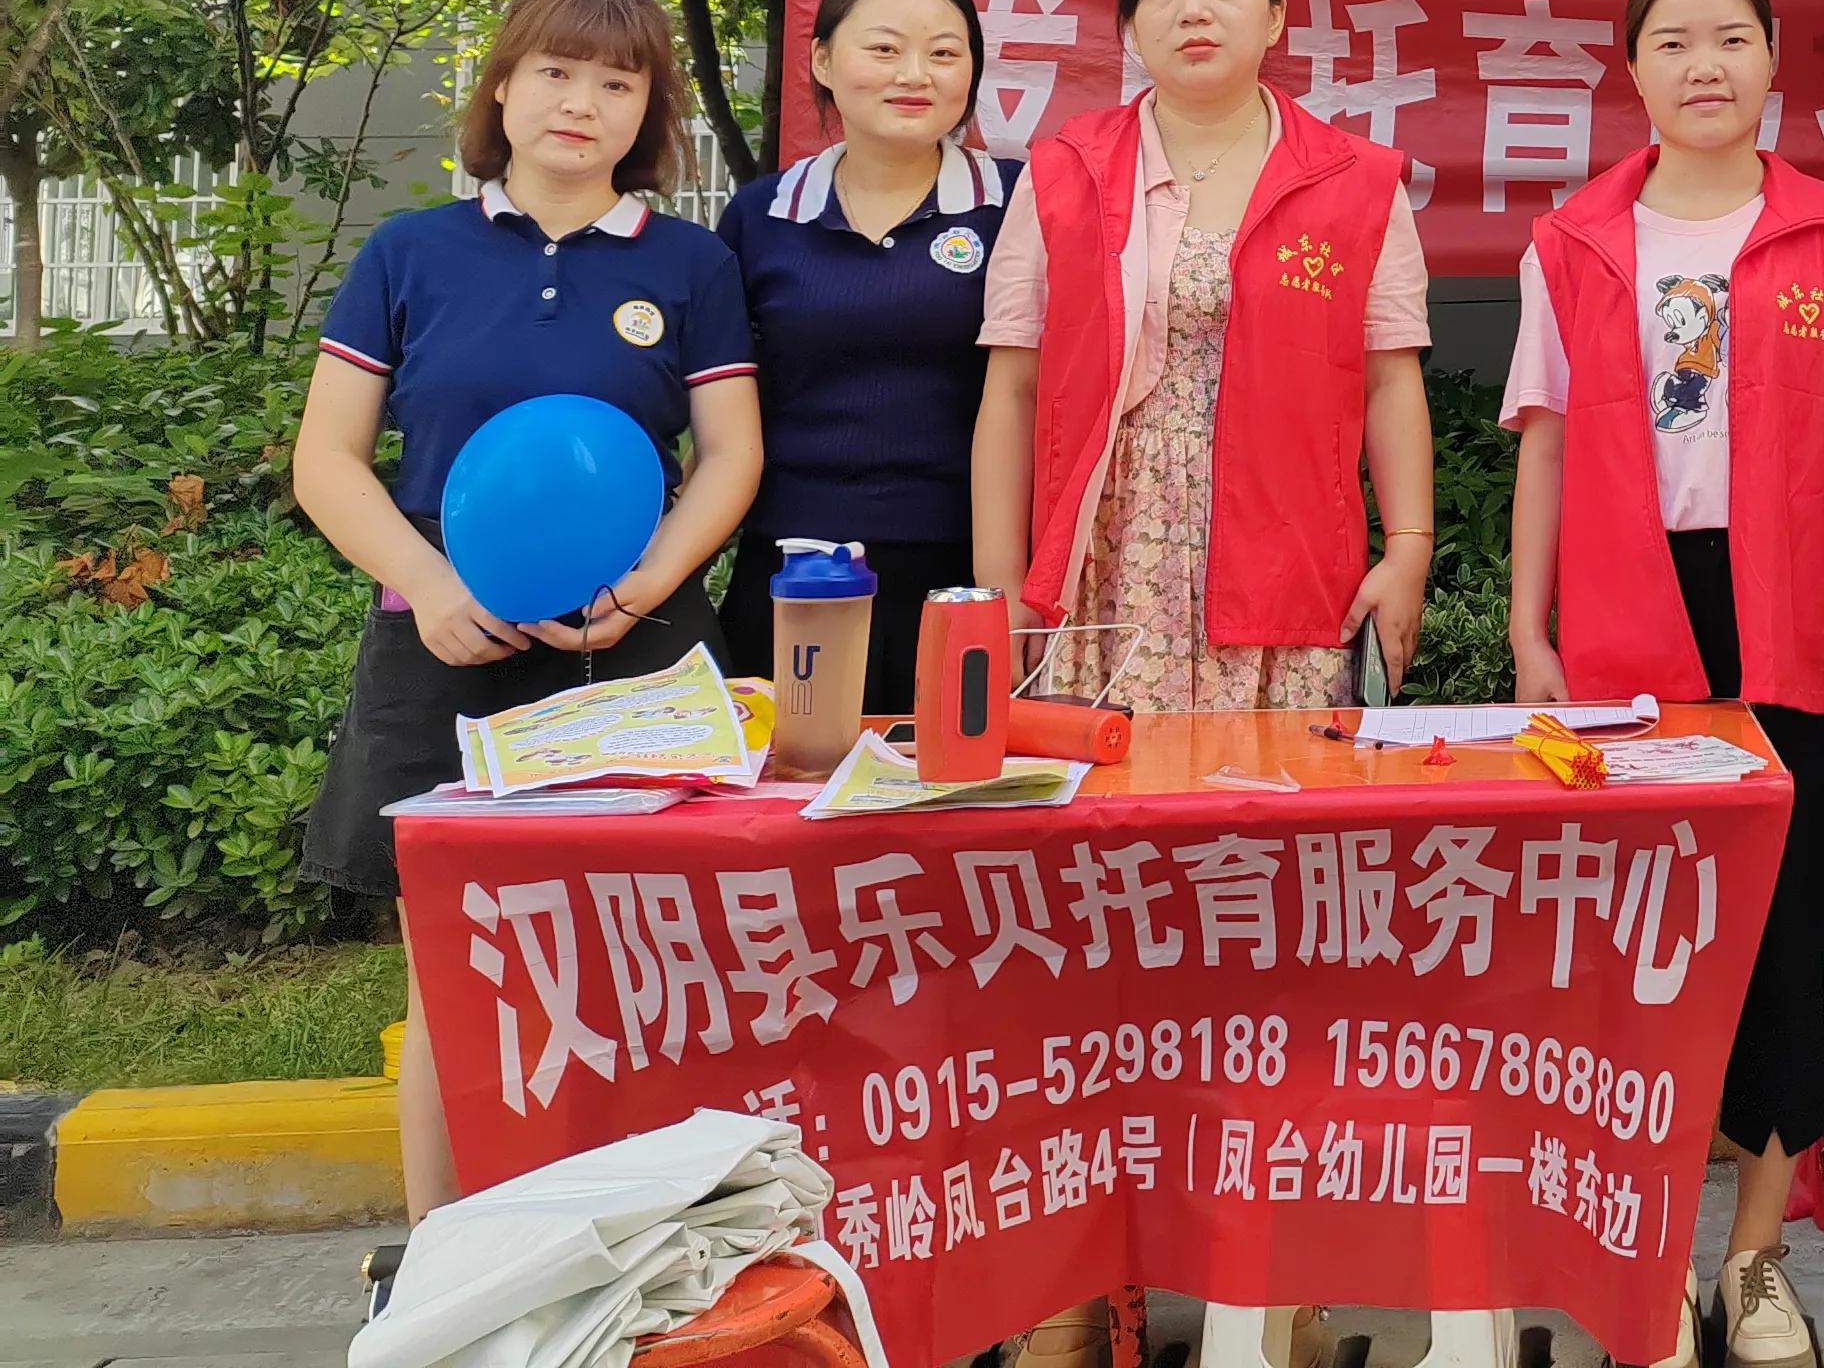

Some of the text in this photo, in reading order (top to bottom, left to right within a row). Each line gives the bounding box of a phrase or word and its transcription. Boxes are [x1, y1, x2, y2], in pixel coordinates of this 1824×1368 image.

[461, 818, 1718, 1118] 汉阴县乐贝托育服务中心
[861, 1013, 1289, 1146] 0915-5298188
[1326, 1017, 1676, 1145] 15667868890
[812, 1112, 1670, 1270] 秀岭凤台路4号（凤台幼儿园一楼东边）
